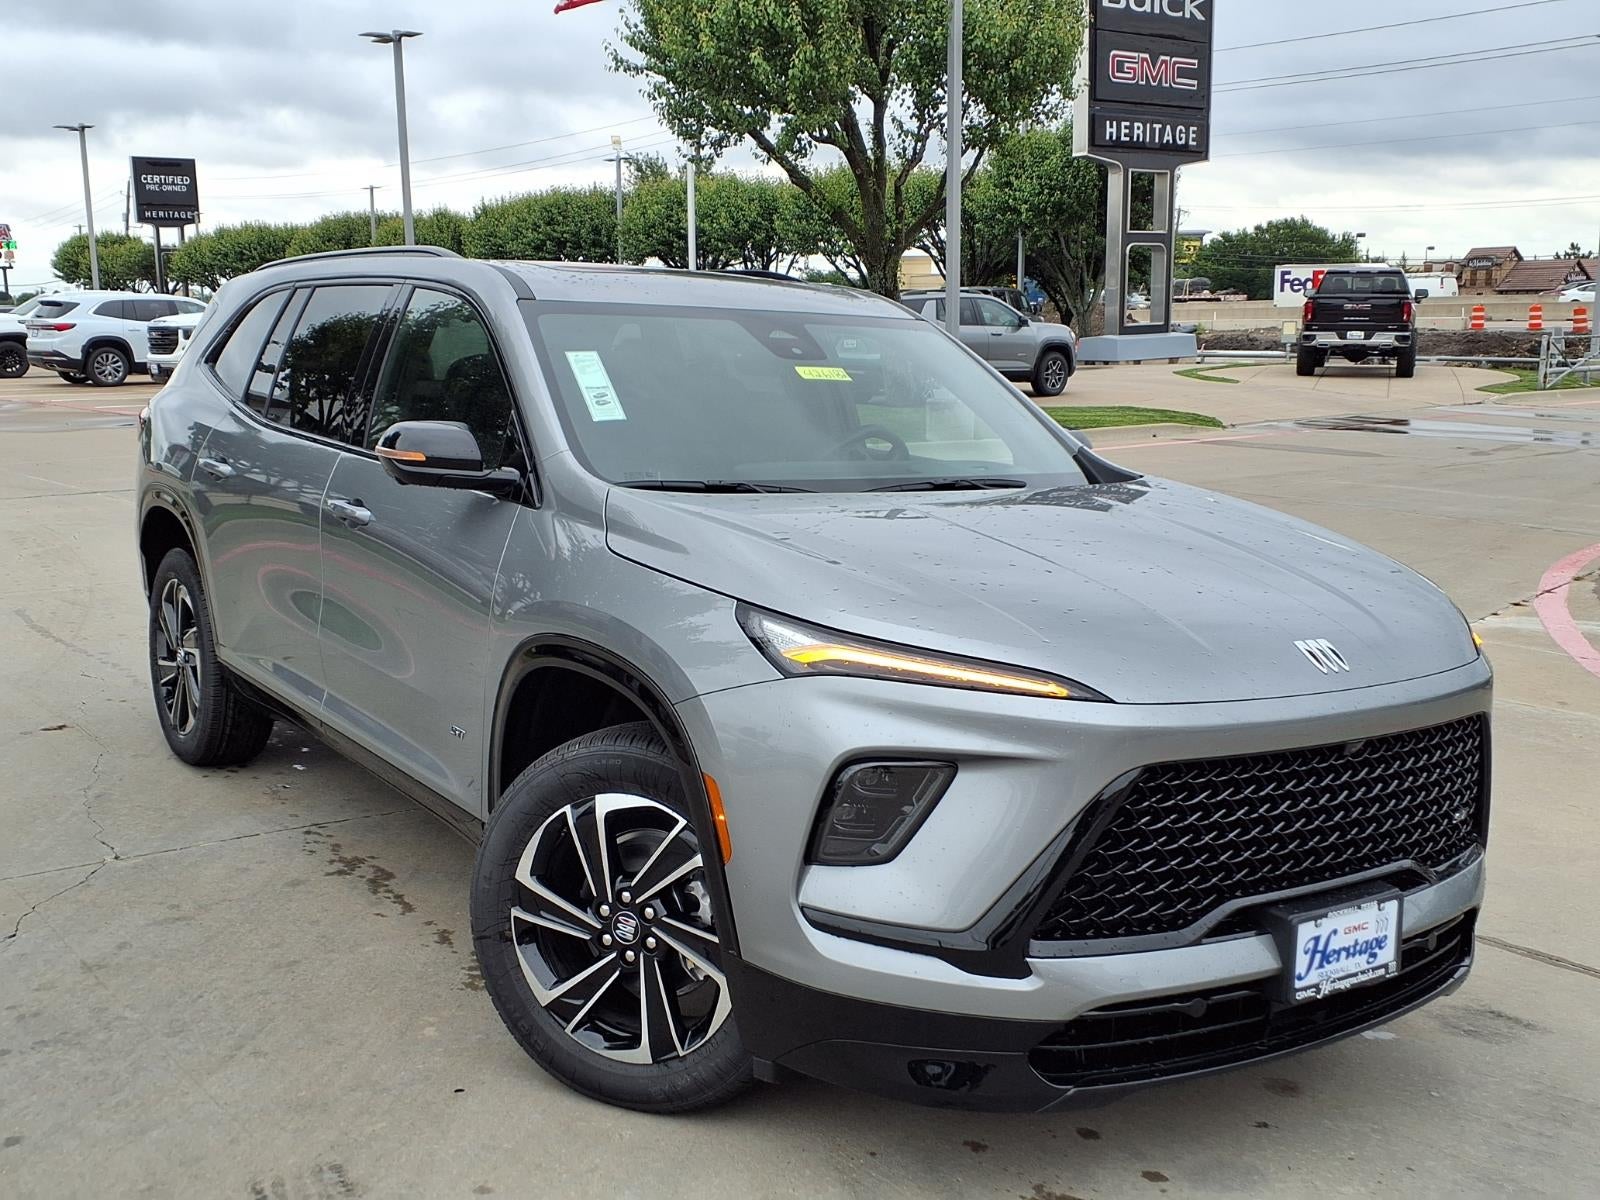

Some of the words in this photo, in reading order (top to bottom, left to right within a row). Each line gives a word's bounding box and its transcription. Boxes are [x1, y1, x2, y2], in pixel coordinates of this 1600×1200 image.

[1109, 50, 1198, 90] GMC
[1105, 120, 1198, 146] HERITAGE
[141, 174, 190, 185] CERTIFIED
[145, 184, 187, 192] PRE-OWNED
[145, 210, 193, 219] HERITAGE
[1343, 922, 1369, 935] GMC
[1295, 928, 1388, 981] Heritage
[1295, 988, 1317, 1000] GMC
